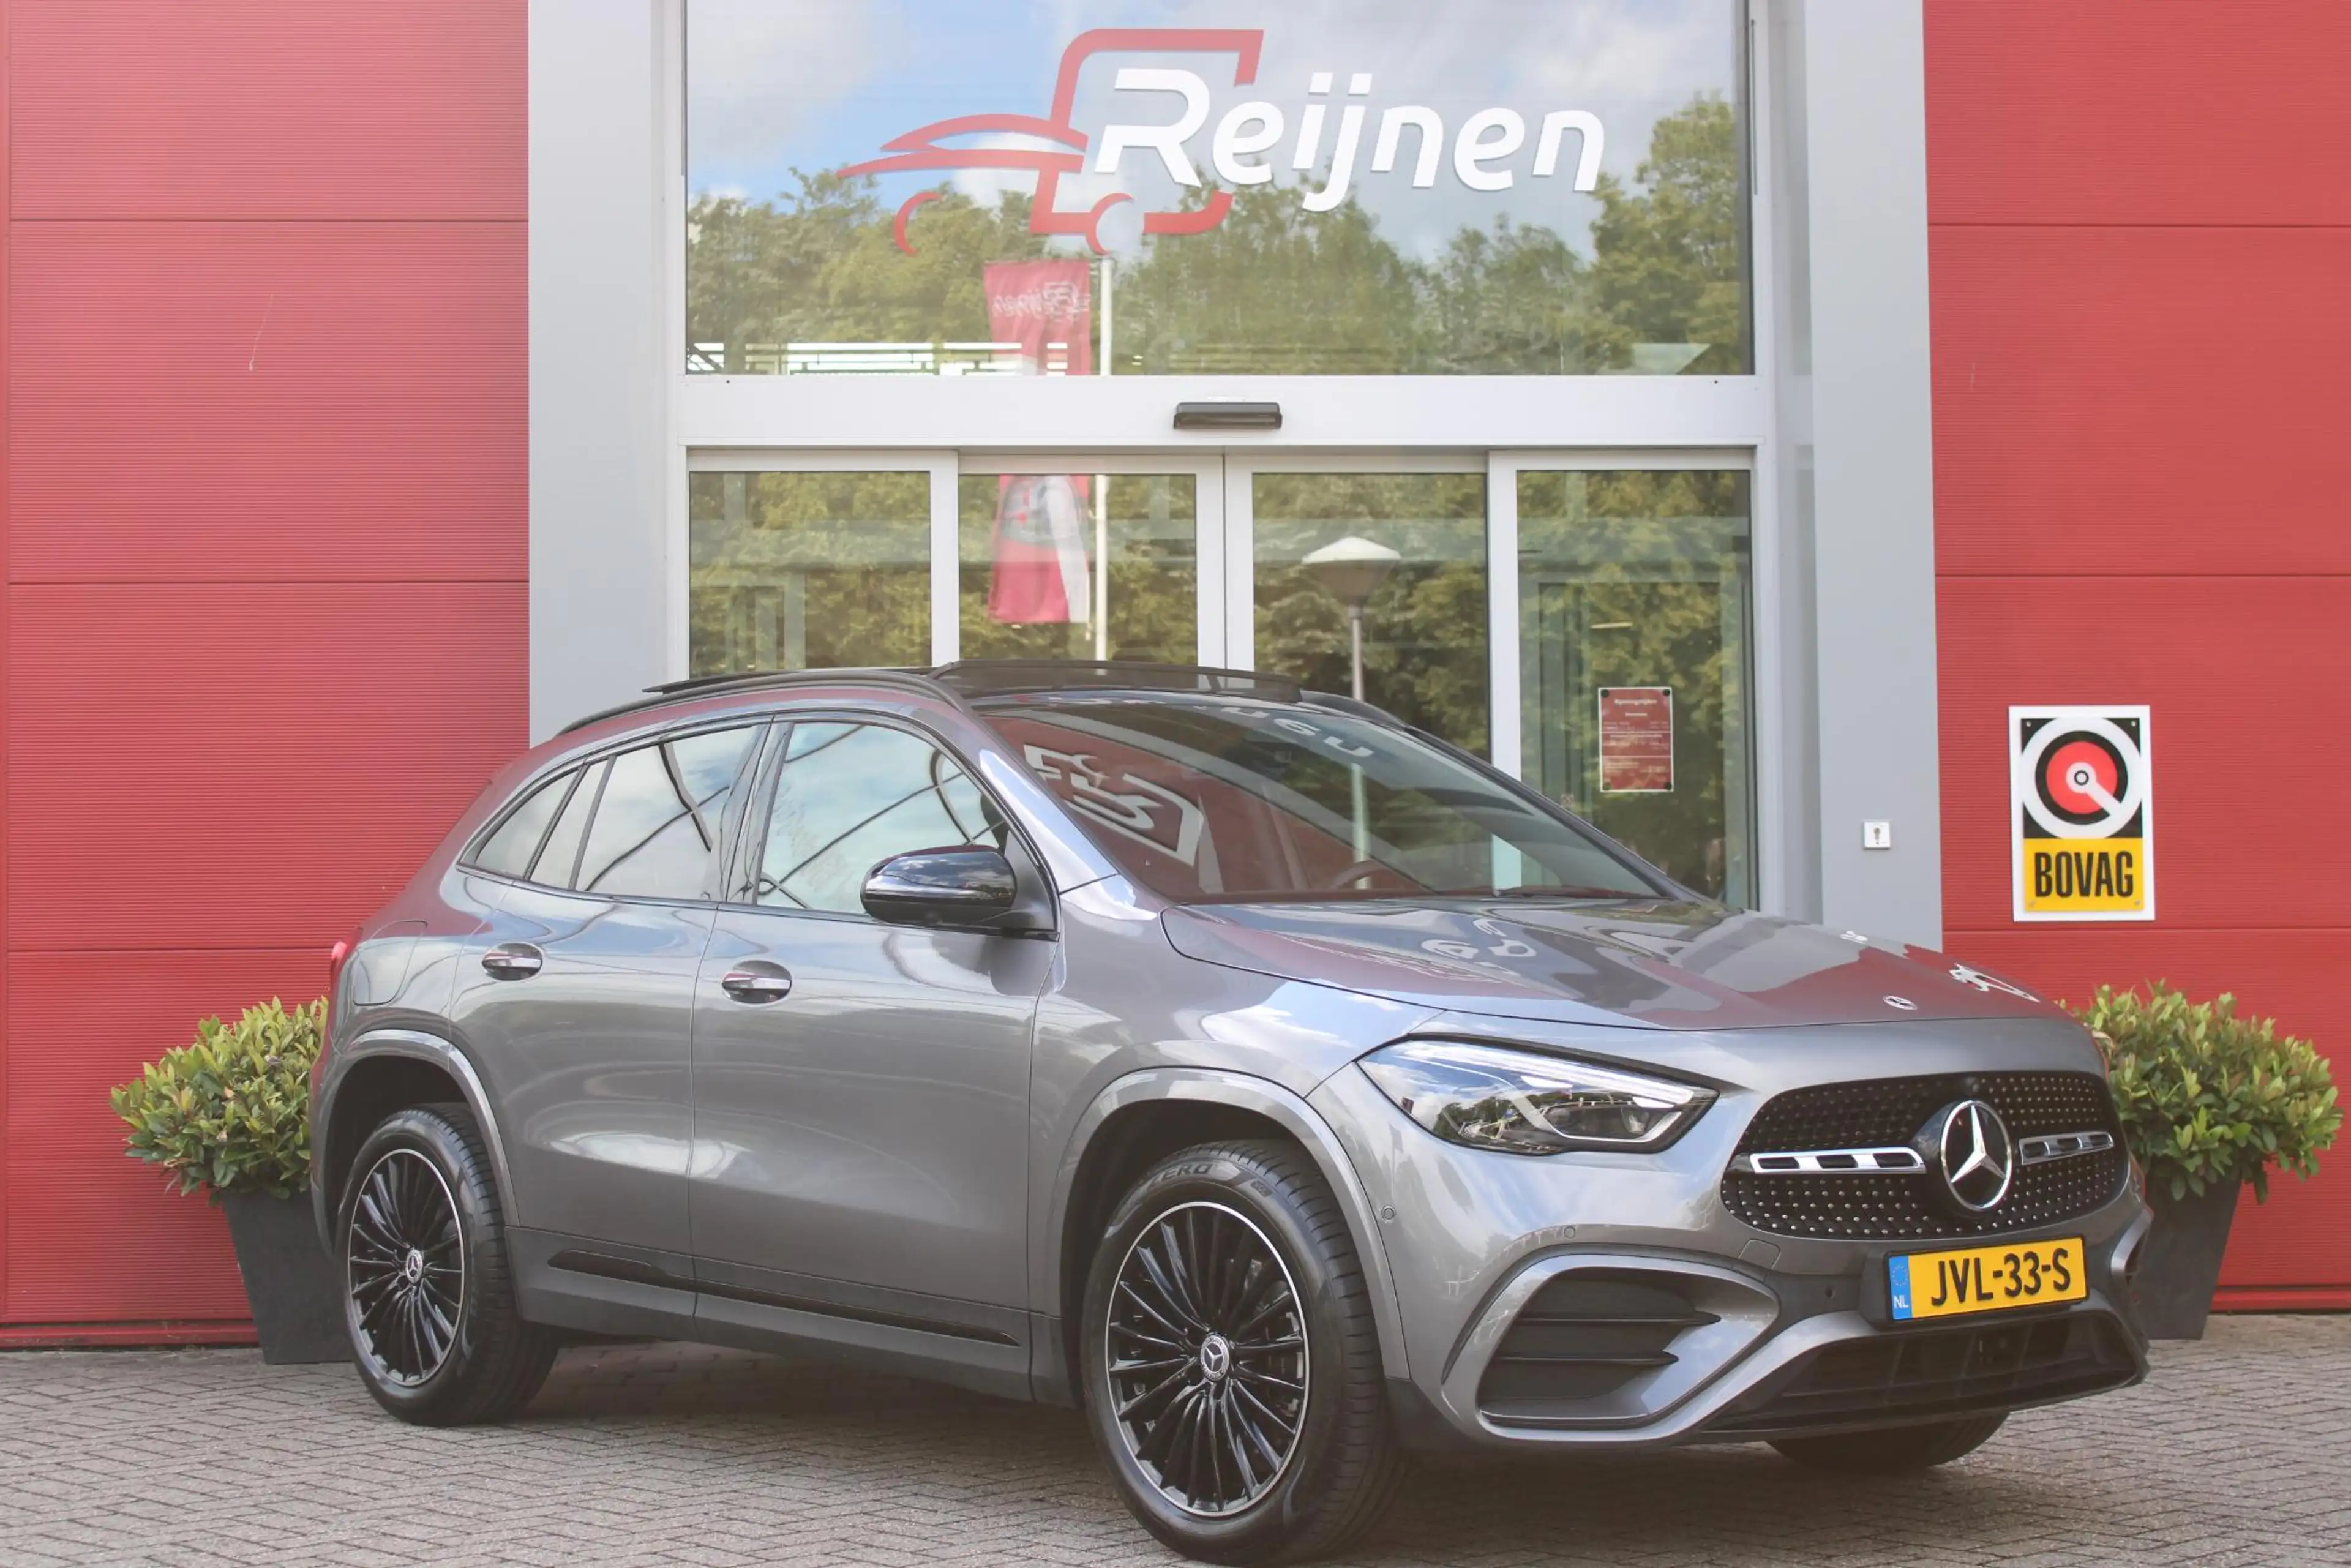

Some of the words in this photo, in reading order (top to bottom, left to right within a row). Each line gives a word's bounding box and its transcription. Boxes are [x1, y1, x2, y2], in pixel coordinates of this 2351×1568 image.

[1095, 68, 1605, 212] Reijnen
[2034, 851, 2134, 898] BOVAG
[1894, 1295, 1908, 1308] NL
[1931, 1248, 2071, 1306] JVL-33-S
